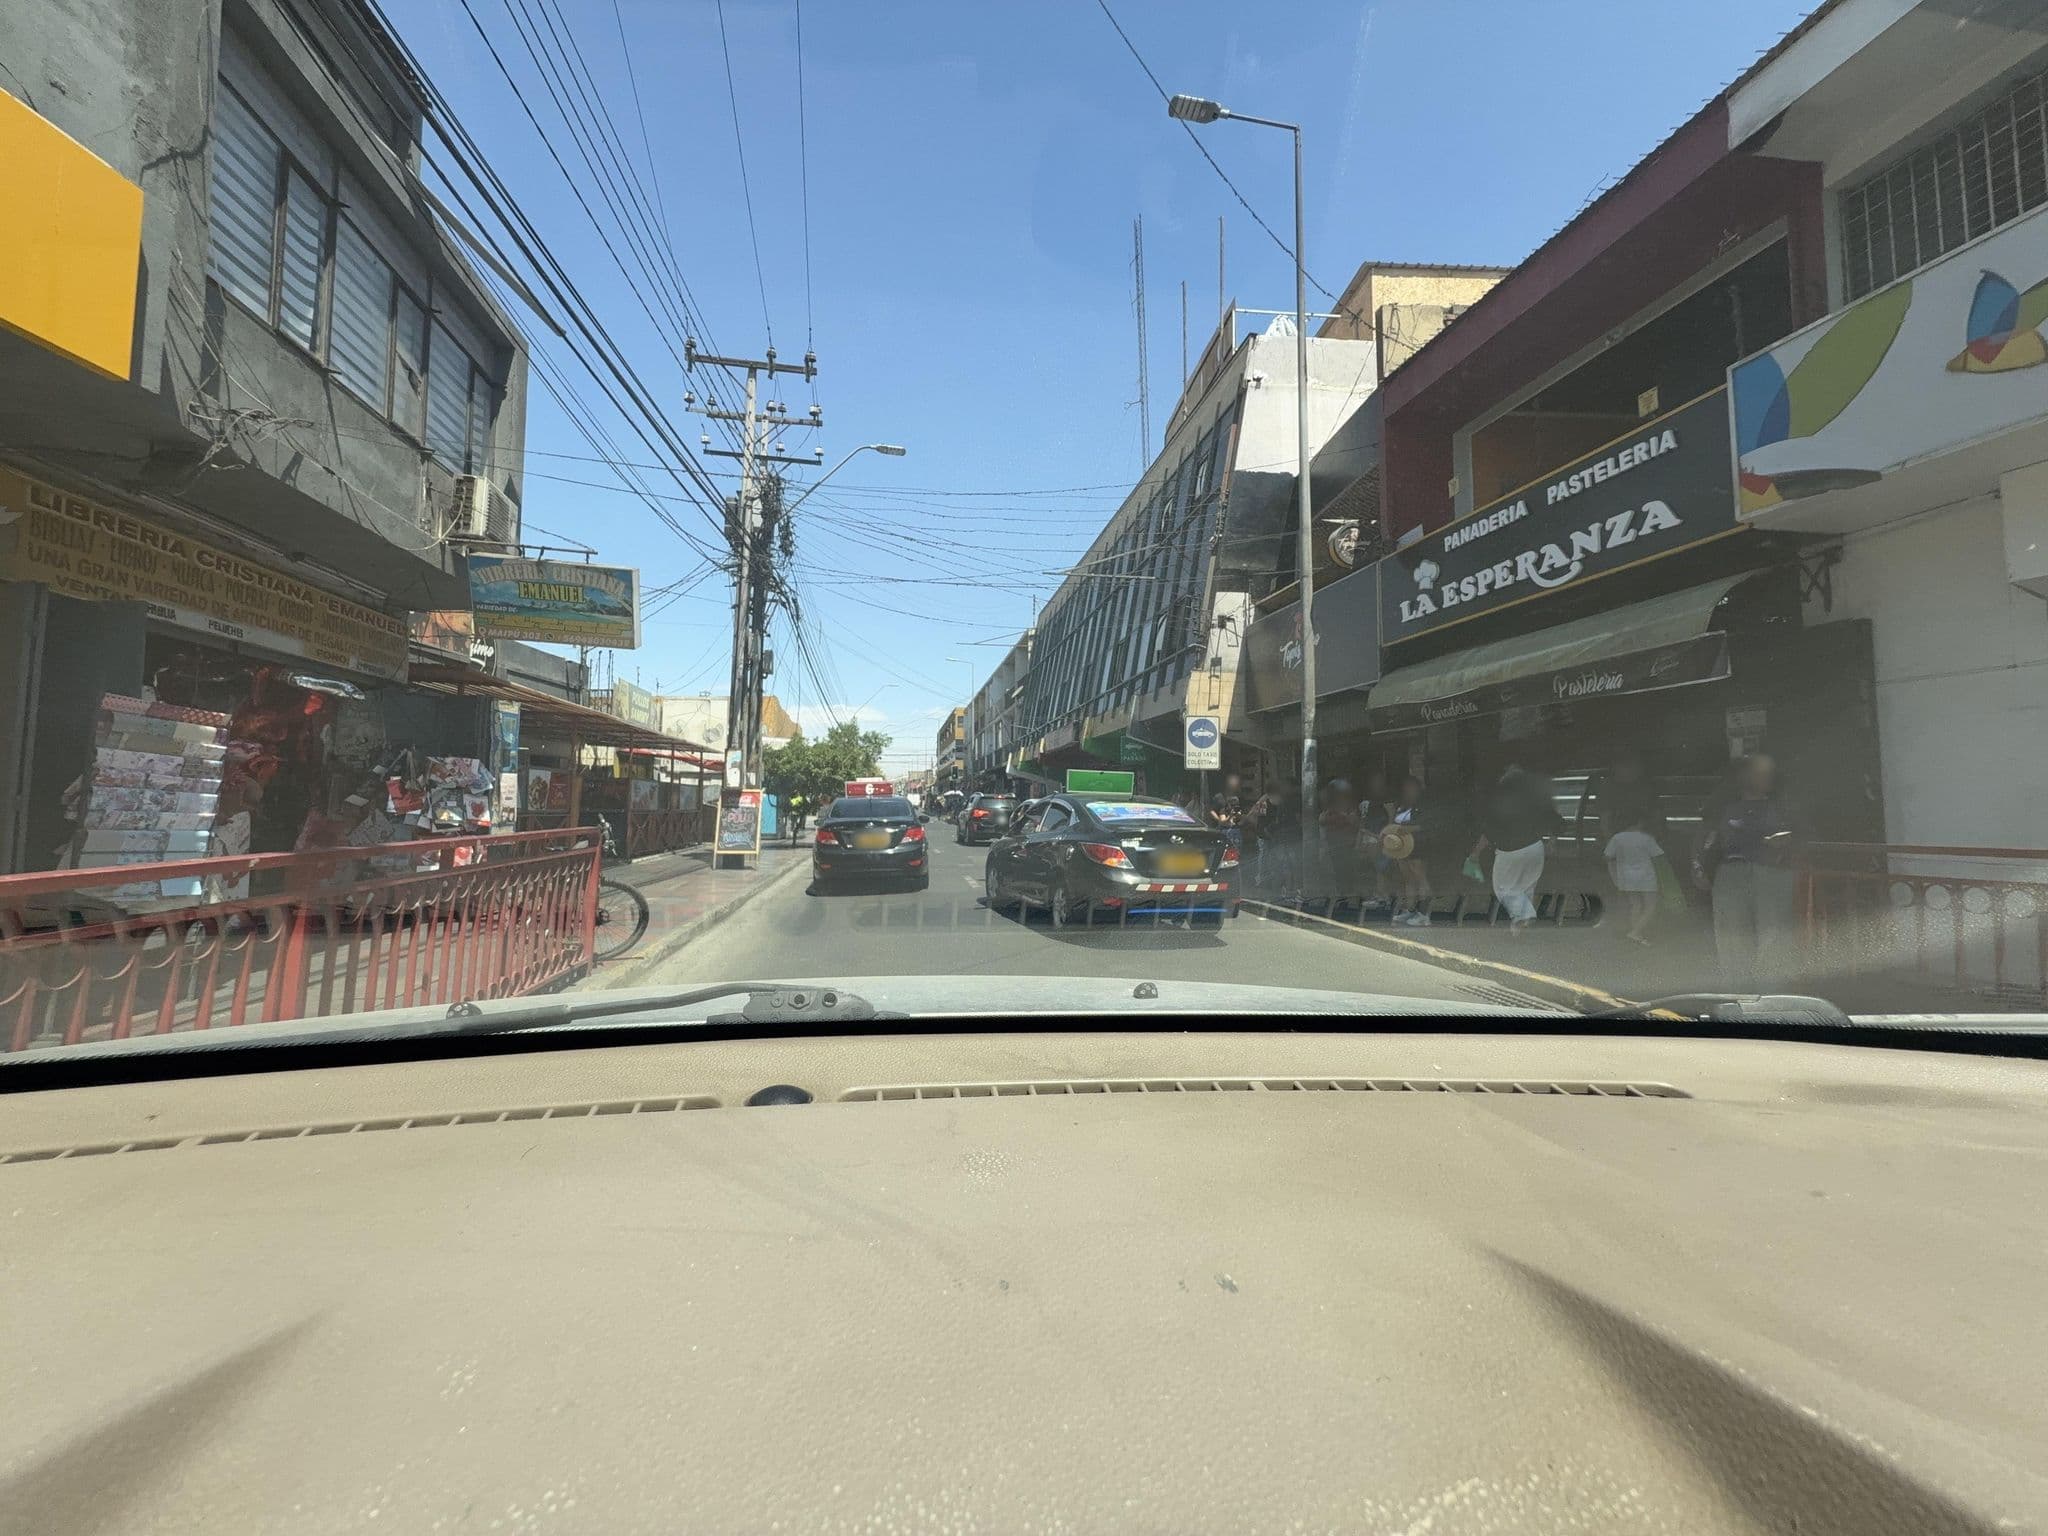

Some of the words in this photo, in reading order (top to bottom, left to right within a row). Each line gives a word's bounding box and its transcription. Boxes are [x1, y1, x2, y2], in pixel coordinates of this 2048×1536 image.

[1444, 500, 1529, 552] PANADERIA
[1546, 430, 1678, 505] PASTELERIA
[27, 540, 71, 572] UNA
[78, 558, 130, 586] GRAN
[133, 574, 209, 612] VARIEDAD
[211, 597, 234, 618] DE
[30, 487, 187, 557] LIBRERIA
[195, 547, 315, 606] CRISTIANA
[518, 581, 585, 604] EMANUEL
[552, 566, 626, 597] CRISTIANA
[1400, 593, 1438, 623] LA
[1441, 500, 1684, 609] ESPERANZA
